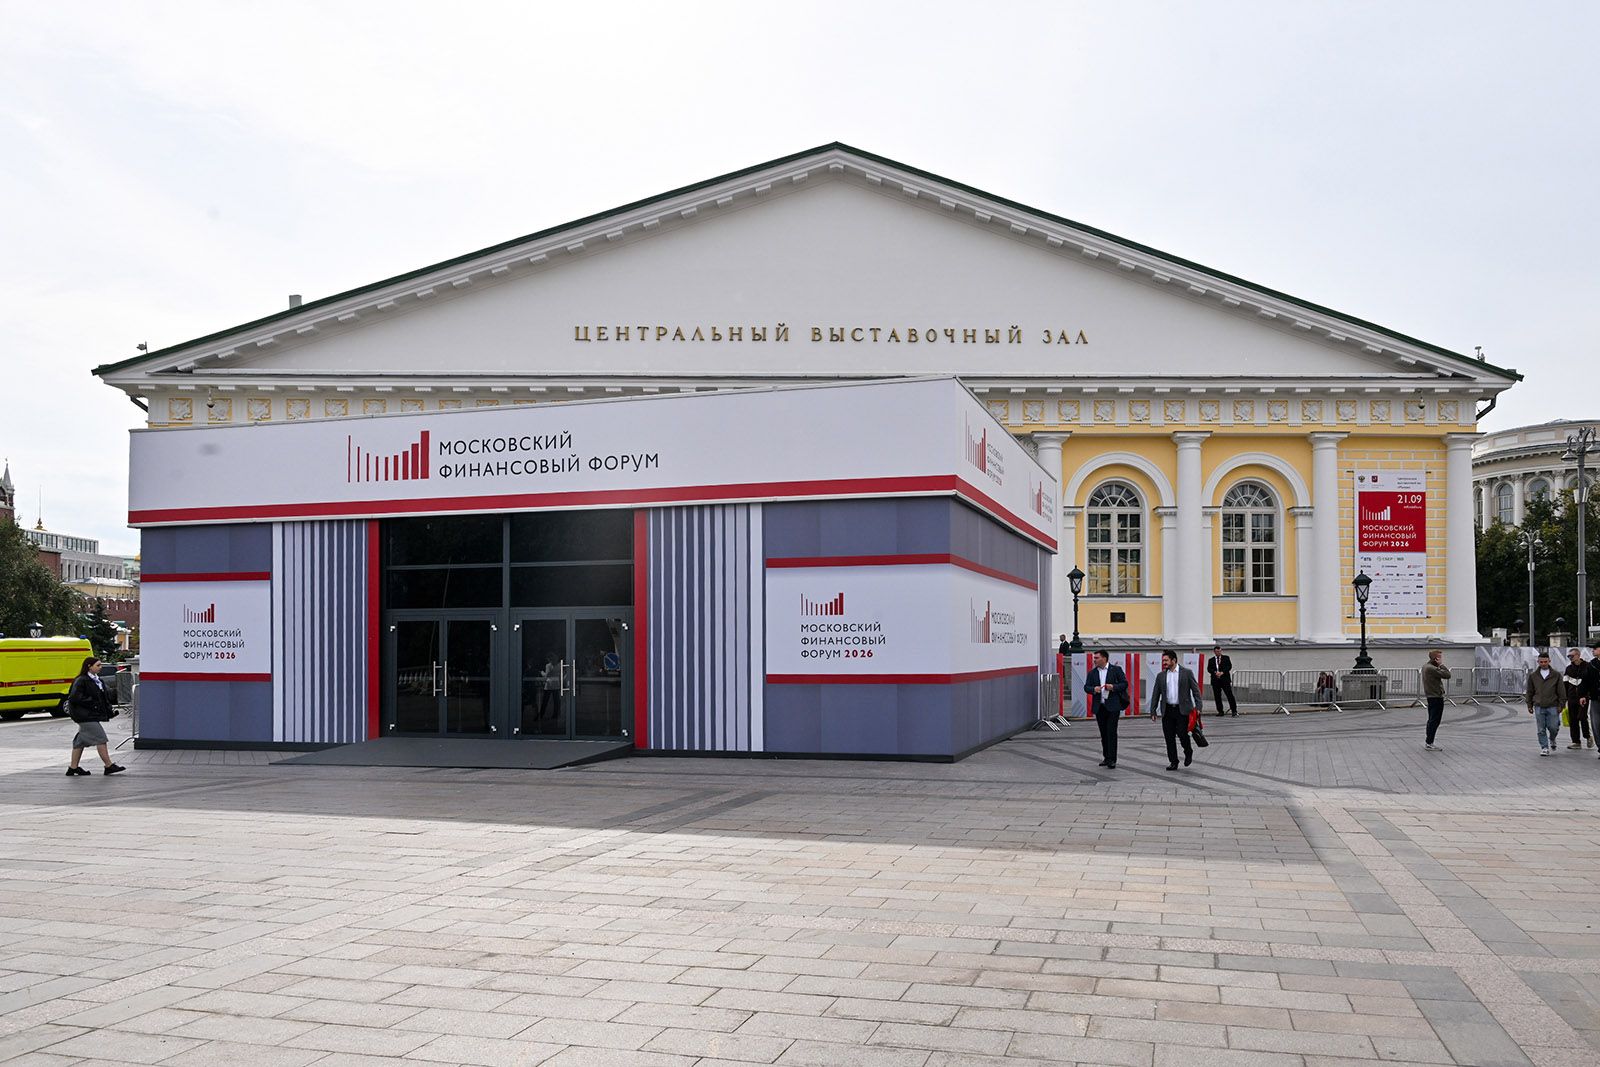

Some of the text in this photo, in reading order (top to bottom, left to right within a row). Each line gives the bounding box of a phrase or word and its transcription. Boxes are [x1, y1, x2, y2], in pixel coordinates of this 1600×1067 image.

[574, 323, 1089, 345] ЦЕНТРАЛЬНЫЙ ВЫСТАВОЧНЫЙ ЗАЛ
[439, 430, 573, 456] МОСКОВСКИЙ
[439, 453, 660, 479] ФИНАНСОВЫЙ ФОРУМ
[1397, 494, 1422, 504] 21.09
[183, 628, 241, 638] МОСКОВСКИЙ
[801, 622, 881, 633] МОСКОВСКИЙ
[183, 639, 245, 648] ФИНАНСОВЫЙ
[801, 634, 886, 645] ФИНАНСОВЫЙ
[183, 651, 236, 660] ФОРУМ 2026
[801, 649, 873, 660] ФОРУМ 2026
